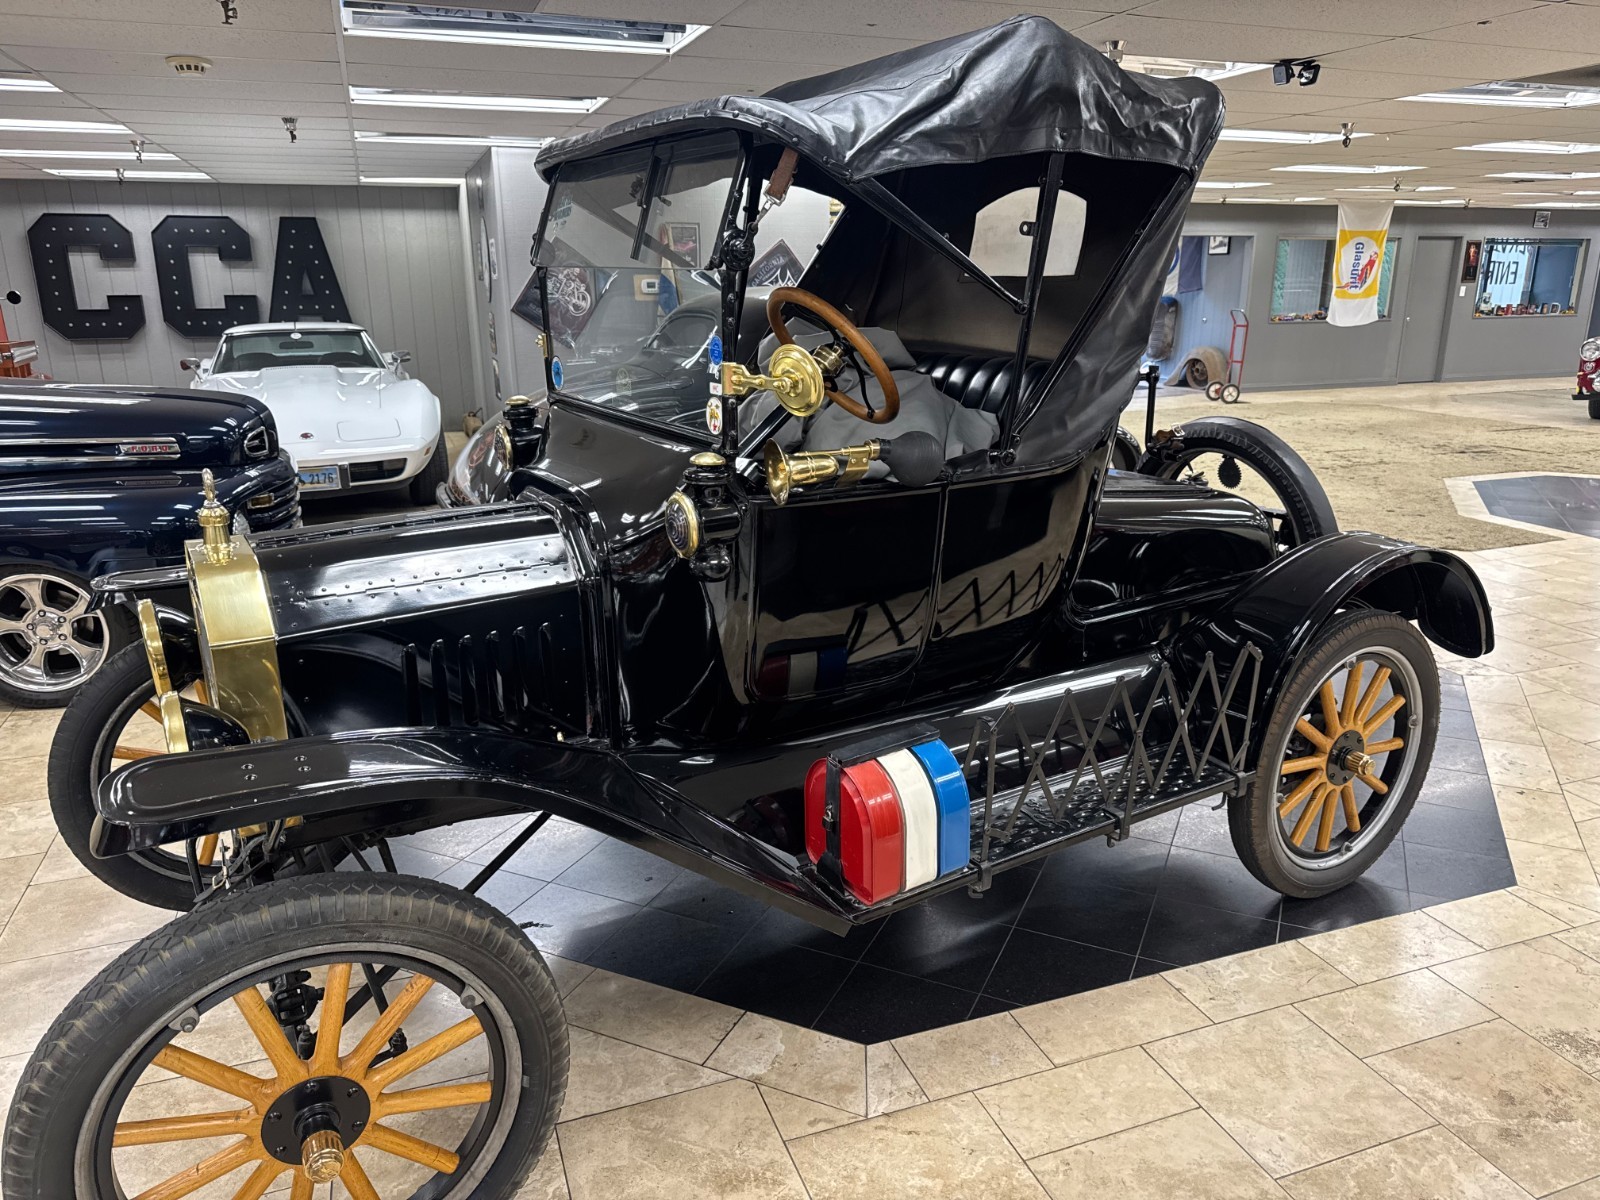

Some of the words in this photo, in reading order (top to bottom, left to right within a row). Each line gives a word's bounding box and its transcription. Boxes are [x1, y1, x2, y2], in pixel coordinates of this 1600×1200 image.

[28, 212, 353, 340] CCA
[751, 255, 785, 287] CALIFORNIA
[1349, 242, 1365, 290] Glasurit
[131, 445, 169, 453] FORD
[309, 472, 334, 484] 2176
